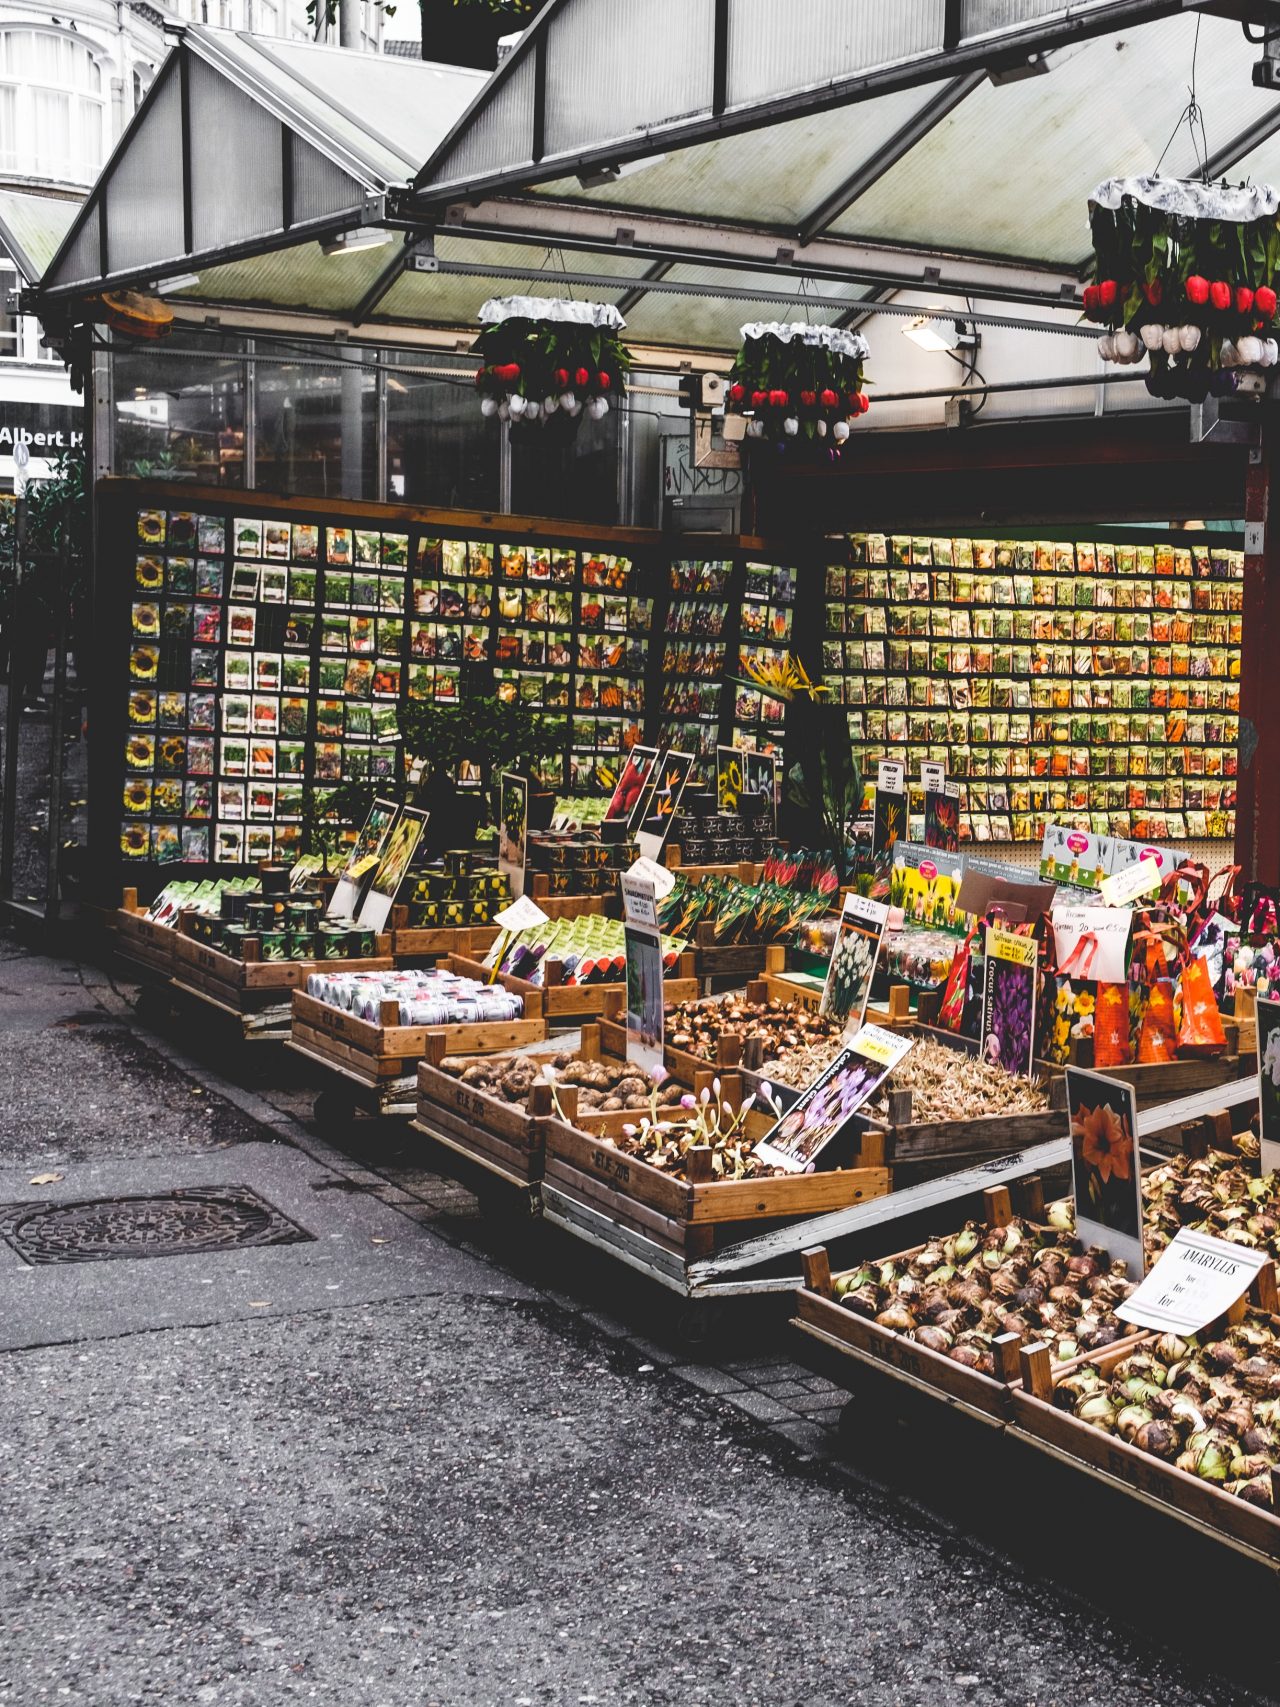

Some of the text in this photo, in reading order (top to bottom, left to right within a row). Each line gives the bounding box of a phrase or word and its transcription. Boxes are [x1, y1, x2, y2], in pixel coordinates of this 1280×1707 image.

[0, 427, 63, 447] Albert
[987, 960, 996, 993] Crocus
[1180, 1249, 1240, 1276] AMARYLLIS
[1157, 1294, 1175, 1307] for
